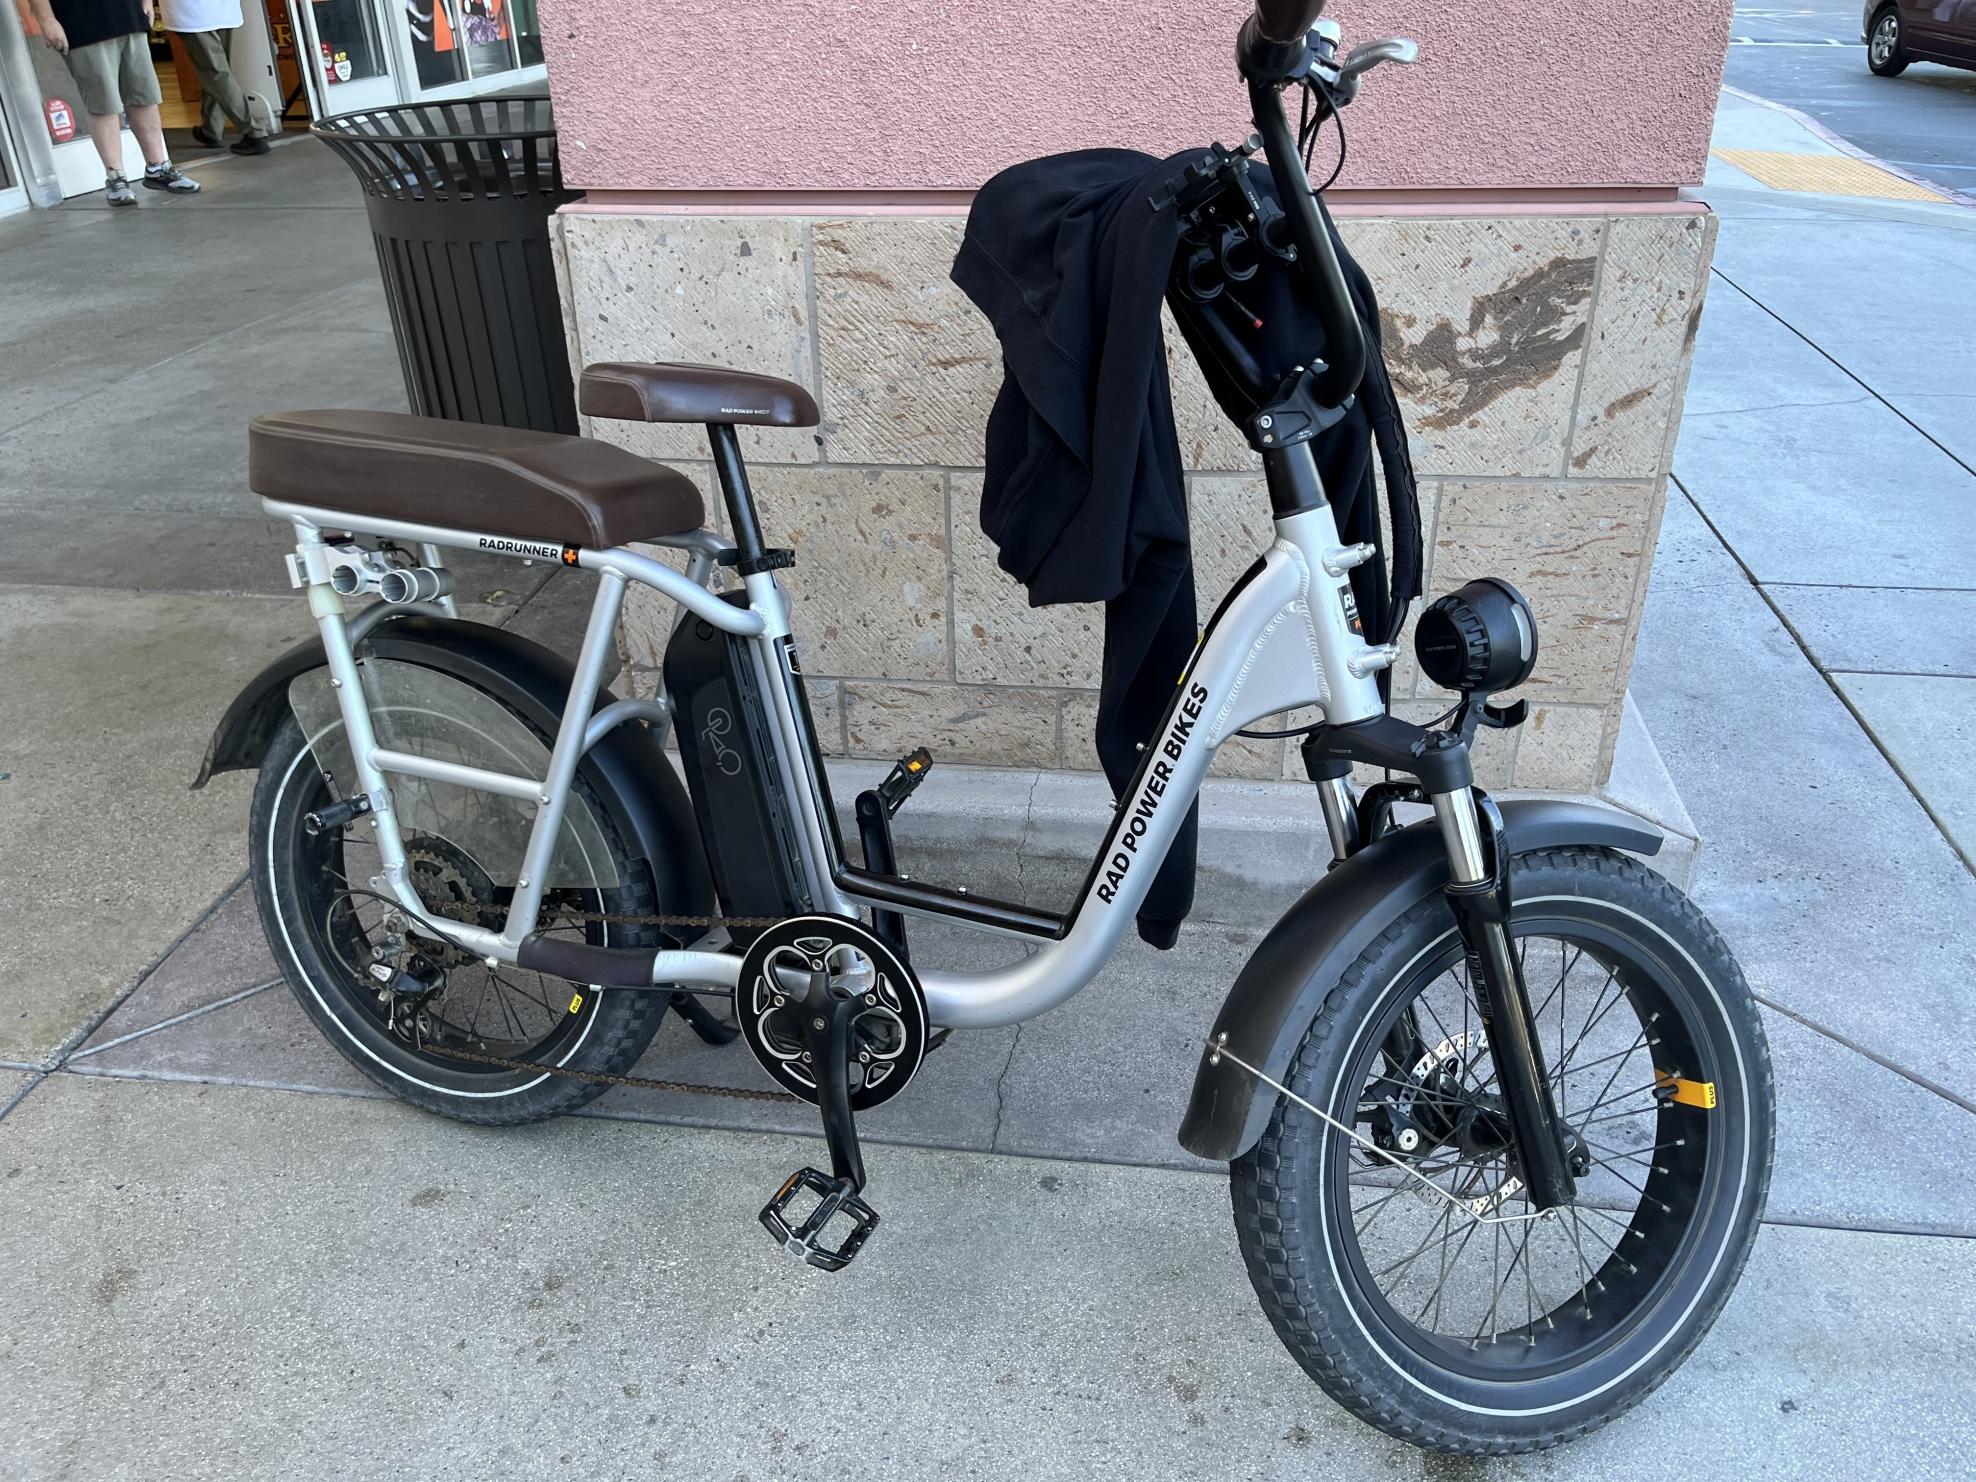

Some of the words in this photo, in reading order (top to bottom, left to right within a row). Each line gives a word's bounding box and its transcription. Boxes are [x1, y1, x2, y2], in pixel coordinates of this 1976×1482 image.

[479, 538, 558, 559] RADRUNNER
[1097, 852, 1130, 904] RAD
[1121, 760, 1174, 853] POWER
[1163, 681, 1209, 762] BIKES
